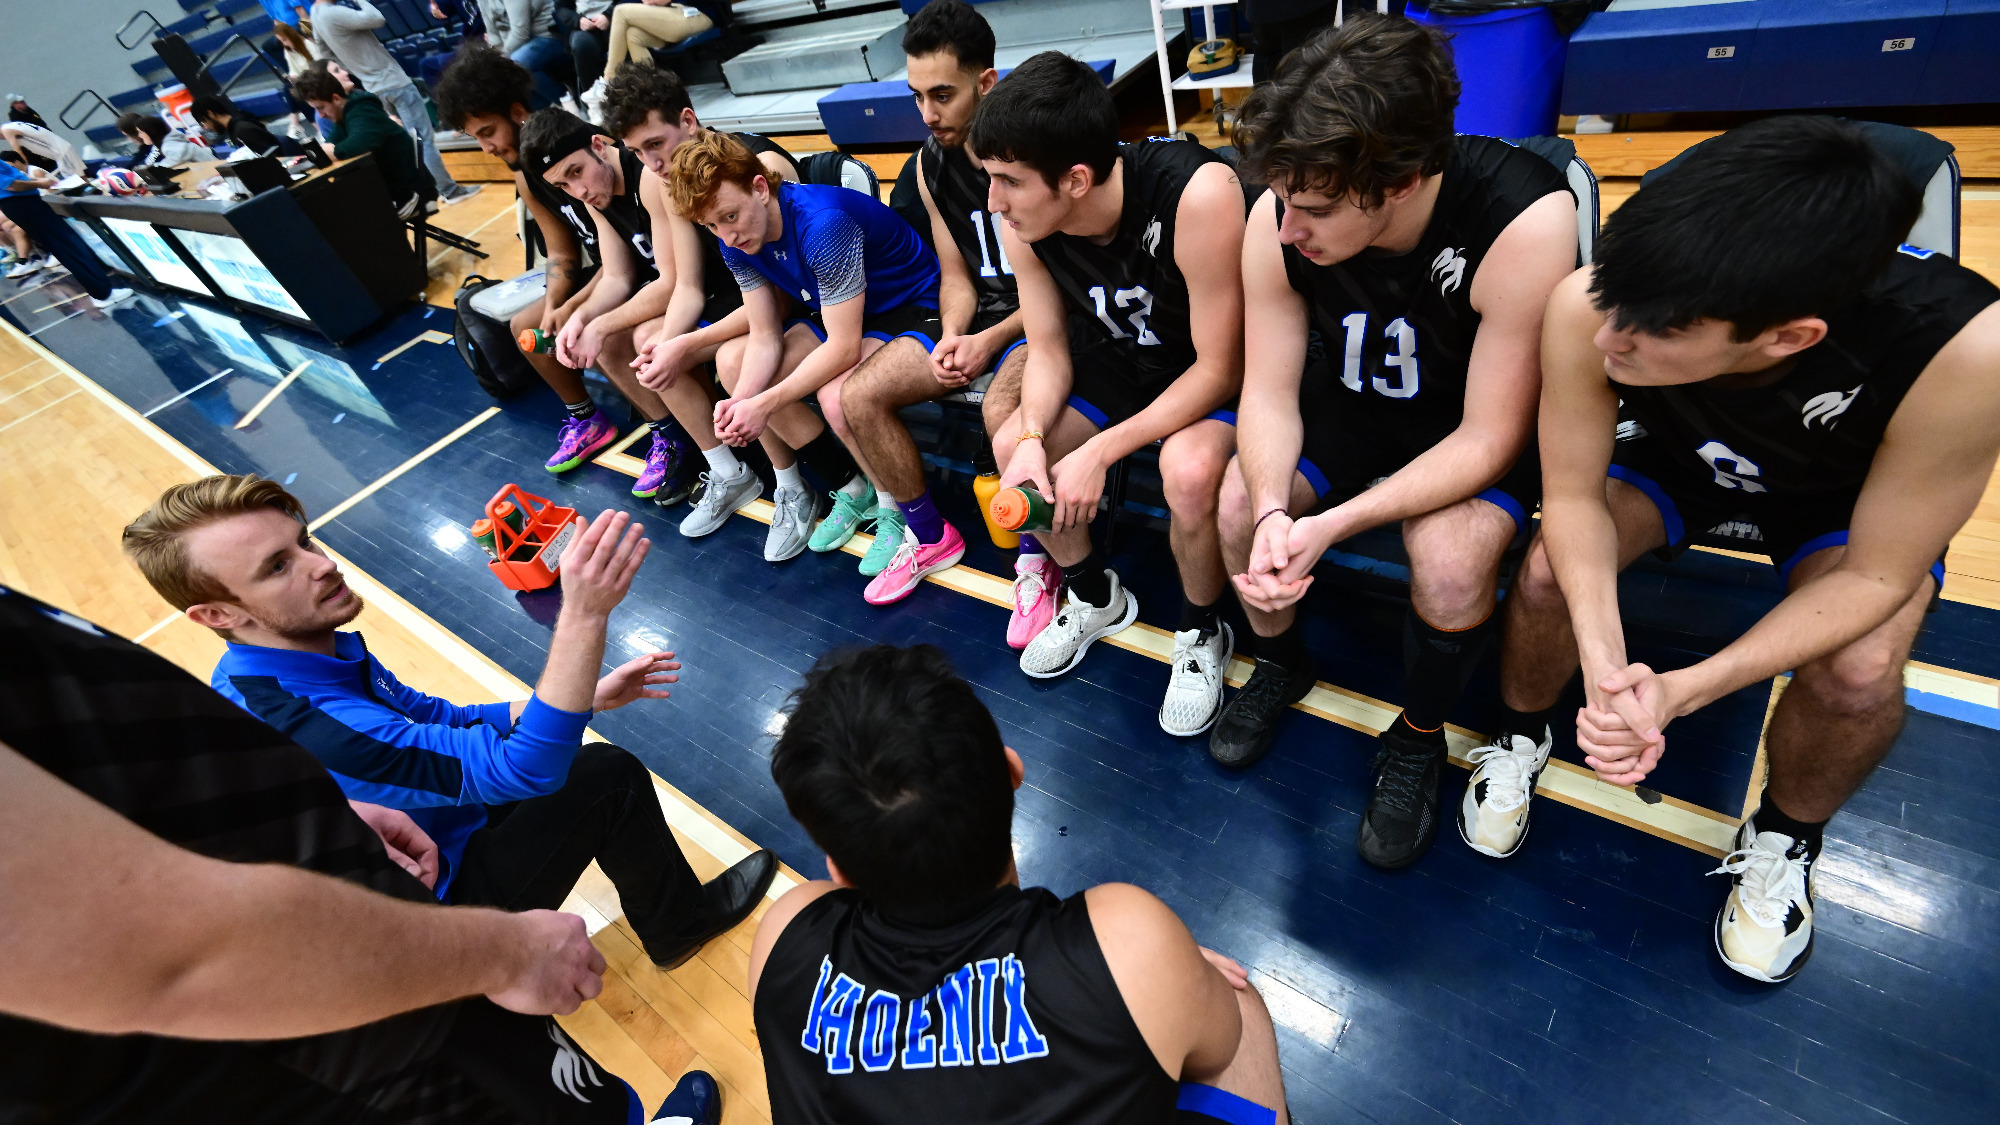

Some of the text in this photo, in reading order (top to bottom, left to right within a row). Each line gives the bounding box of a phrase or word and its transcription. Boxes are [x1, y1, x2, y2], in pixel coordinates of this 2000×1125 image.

[1714, 48, 1727, 56] 55
[1890, 40, 1906, 49] 56
[1088, 285, 1162, 346] 12
[1340, 311, 1420, 399] 13
